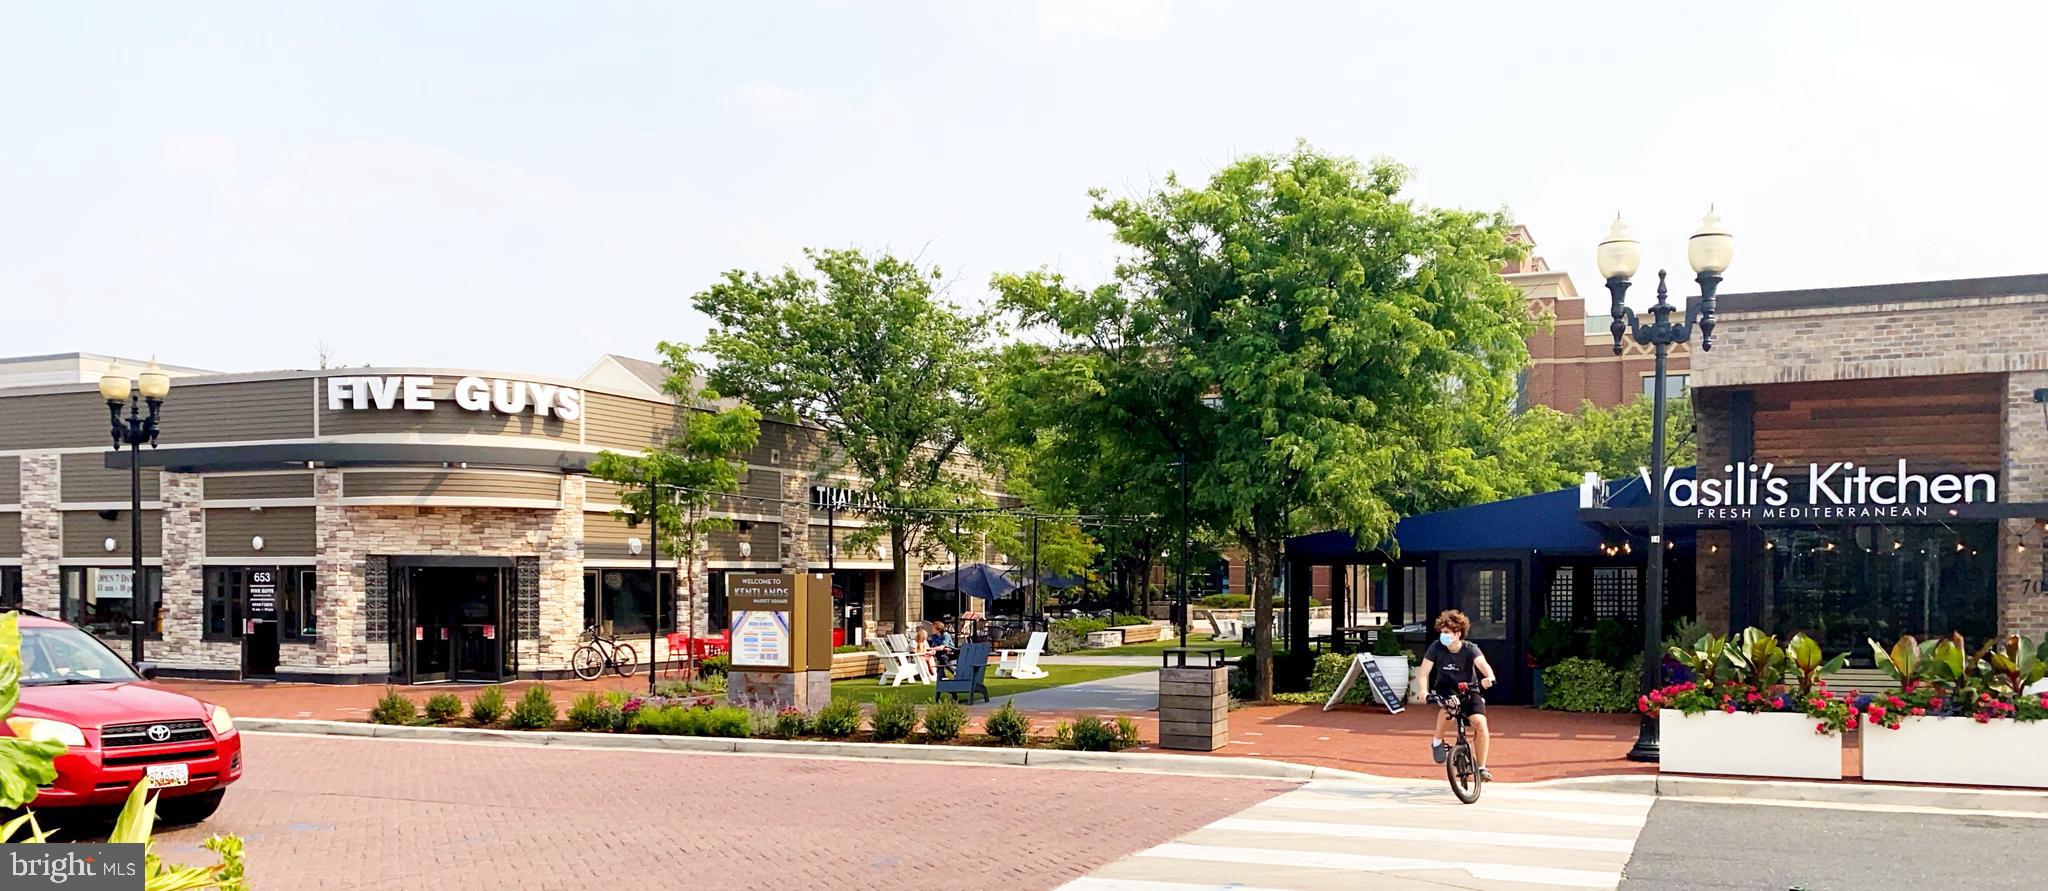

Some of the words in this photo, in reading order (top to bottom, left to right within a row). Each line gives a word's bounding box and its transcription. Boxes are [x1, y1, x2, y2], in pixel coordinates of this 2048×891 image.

[327, 376, 435, 410] FIVE
[455, 376, 581, 421] GUYS
[1639, 462, 1789, 507] Vasili's
[1809, 458, 1996, 505] Kitchen
[1697, 508, 1751, 519] FRESH
[1763, 506, 1927, 519] MEDITERRANEAN
[253, 572, 271, 583] 653
[734, 587, 789, 598] KENTLANDS
[2020, 578, 2042, 595] 70
